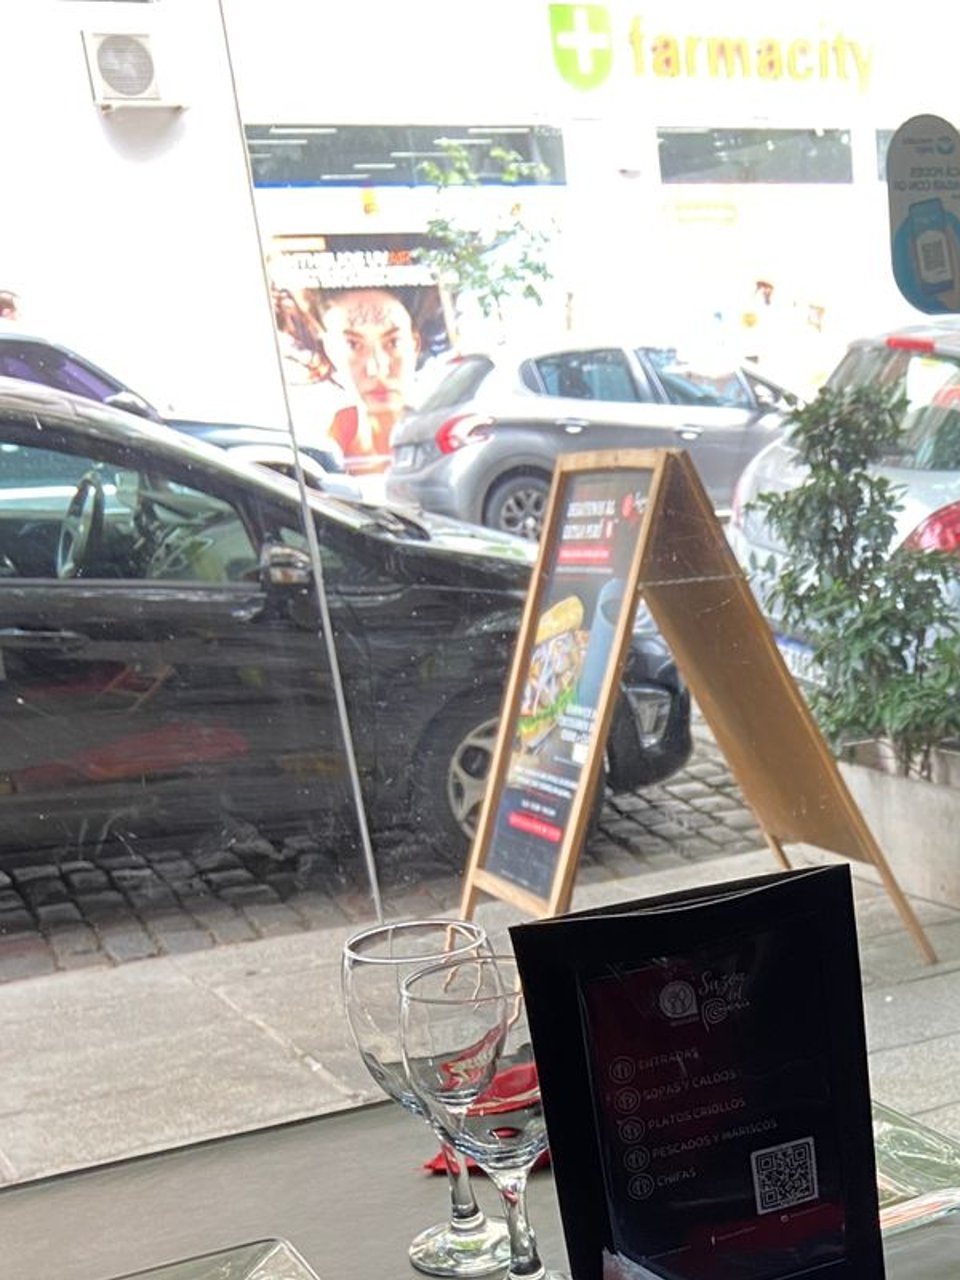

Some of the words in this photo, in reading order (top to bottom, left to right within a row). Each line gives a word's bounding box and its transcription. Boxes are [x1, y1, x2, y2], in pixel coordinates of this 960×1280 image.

[627, 12, 876, 94] farmacity
[638, 1050, 700, 1071] ENTRADAS
[643, 1081, 681, 1103] SOPAS
[692, 1069, 737, 1090] CALDOS
[647, 1111, 692, 1131] PLATOS
[693, 1097, 747, 1120] CRIOLLOS
[651, 1136, 712, 1161] PESCADOS
[722, 1118, 778, 1142] MARISCOS
[657, 1167, 698, 1188] CHIFAS
